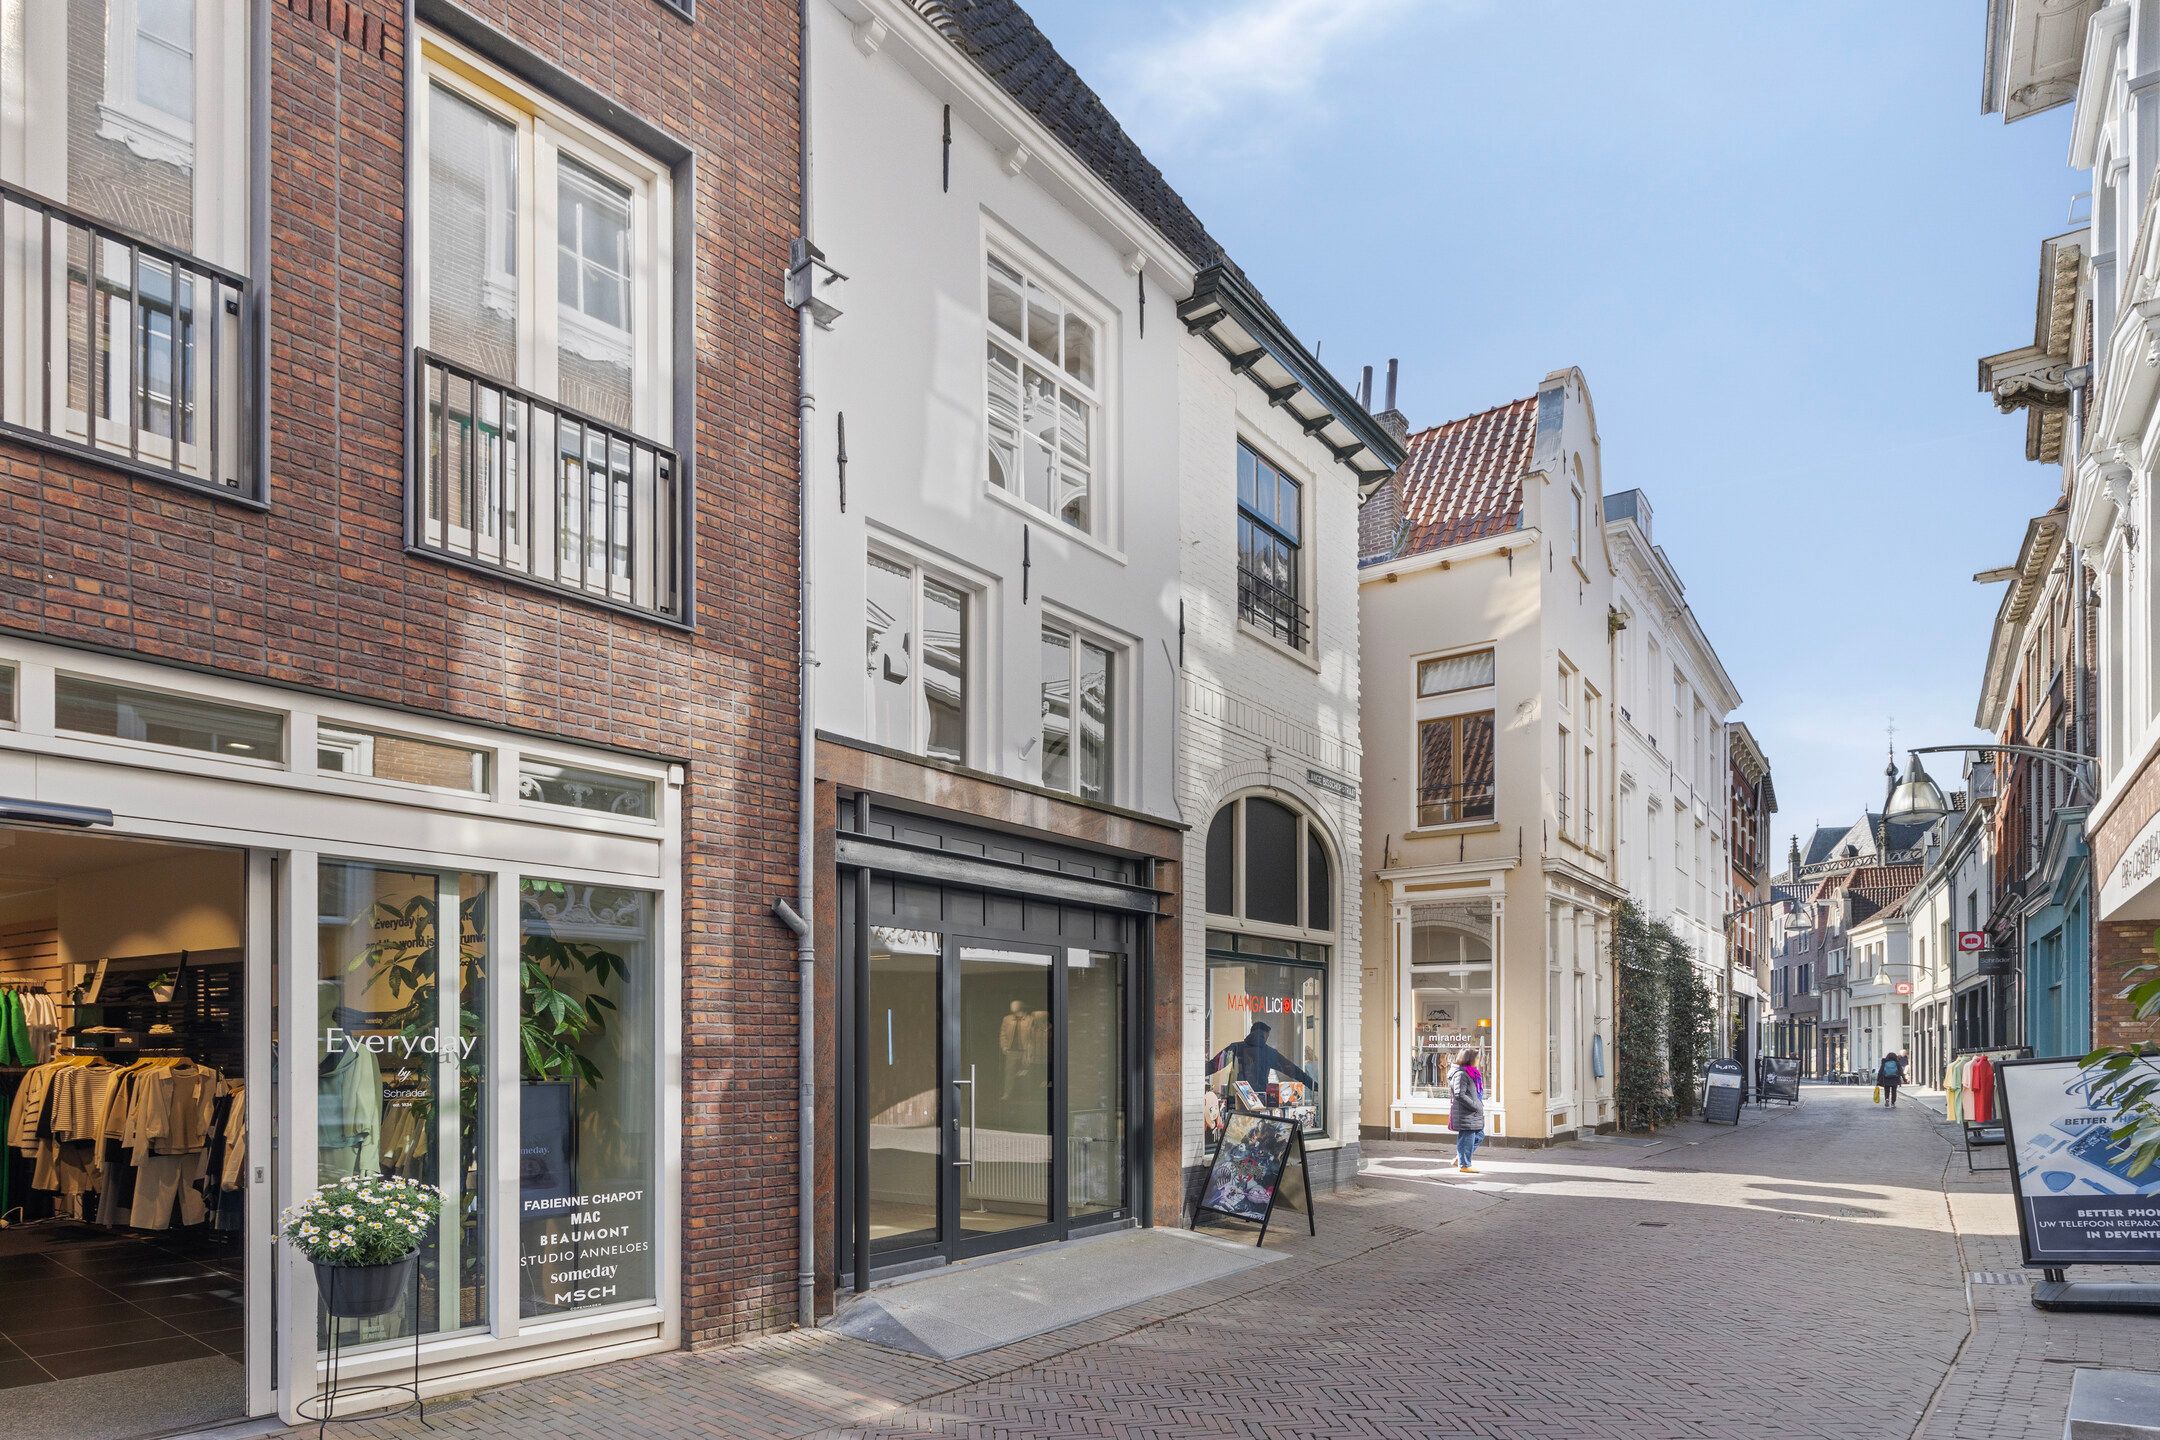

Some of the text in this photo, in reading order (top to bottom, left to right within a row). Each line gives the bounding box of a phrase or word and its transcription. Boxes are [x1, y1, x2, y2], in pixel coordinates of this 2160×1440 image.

[326, 1027, 477, 1060] Everyday
[1428, 1033, 1472, 1042] mirander
[397, 1066, 412, 1082] by
[383, 1089, 427, 1098] Schräder
[2064, 1116, 2107, 1126] BETTER
[524, 1190, 643, 1211] FABIENNE CHAPOT
[570, 1210, 601, 1226] MAC
[2077, 1209, 2124, 1218] BETTER
[2039, 1220, 2056, 1228] UW
[2059, 1220, 2114, 1228] TELEFOON
[540, 1225, 629, 1246] BEAUMONT
[2086, 1231, 2101, 1239] IN
[520, 1241, 649, 1267] STUDIO ANNELOES
[550, 1264, 618, 1284] someday
[554, 1284, 616, 1305] MSCH
